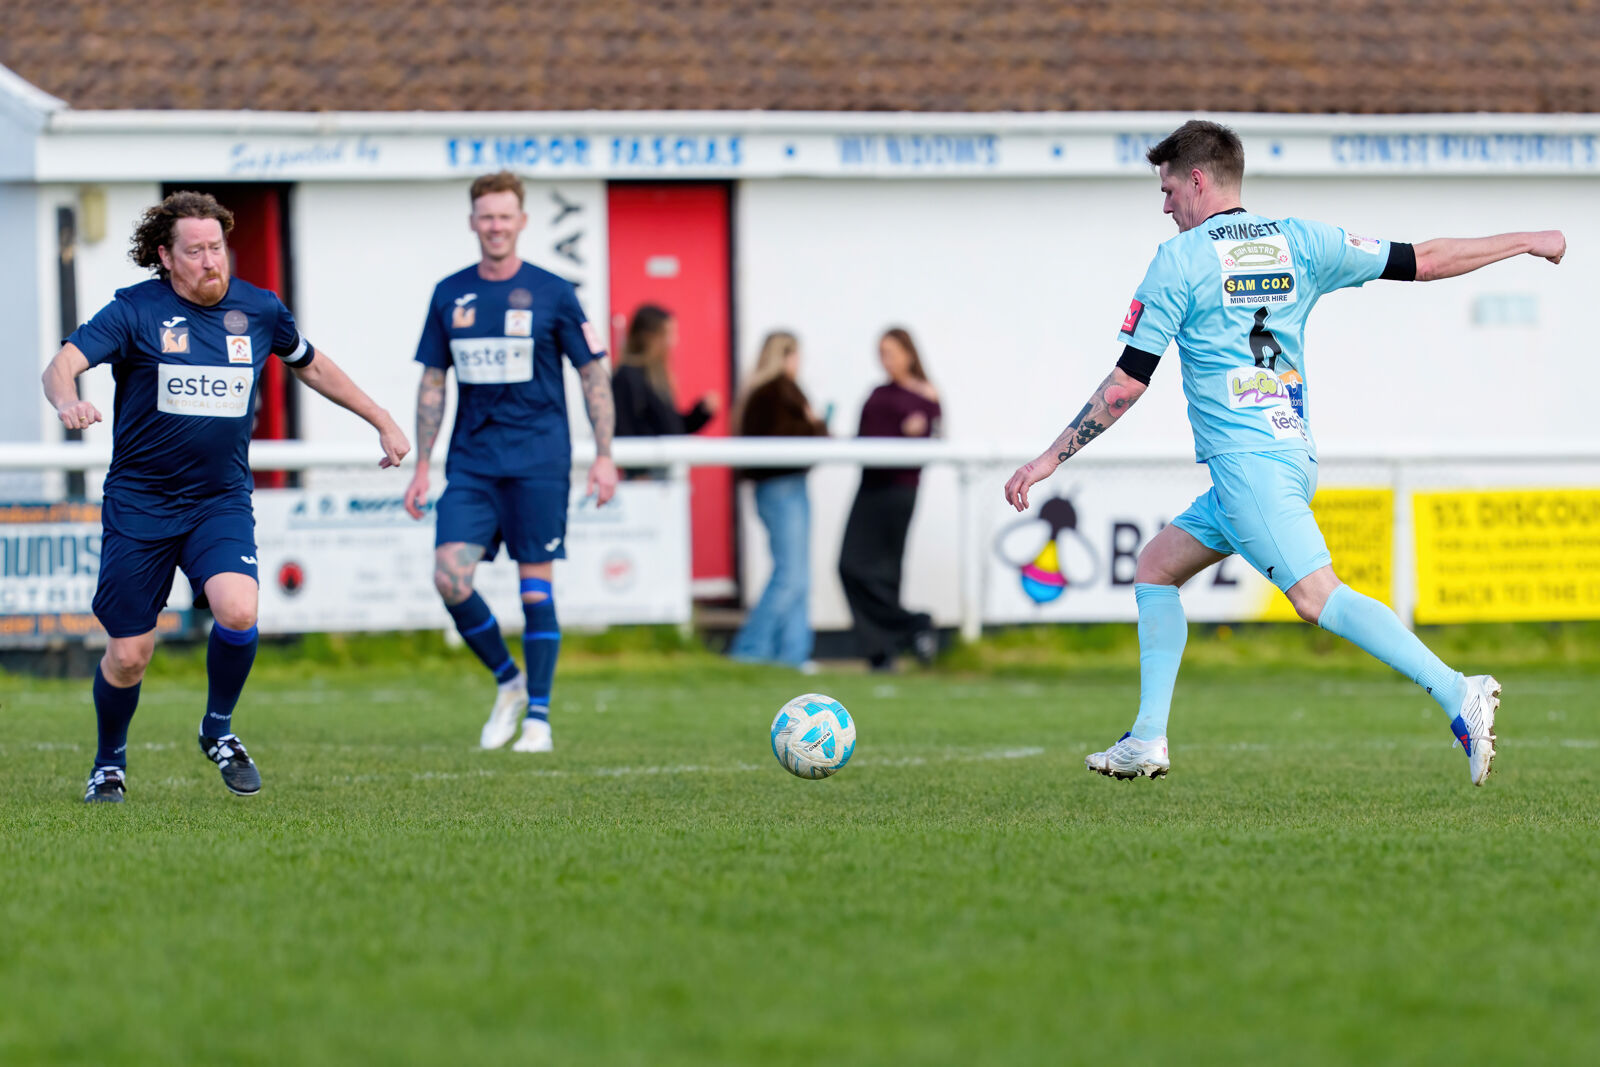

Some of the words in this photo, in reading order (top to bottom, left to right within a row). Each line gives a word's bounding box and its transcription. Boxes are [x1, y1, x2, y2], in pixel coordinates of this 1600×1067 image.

[1207, 221, 1281, 241] SPRINGETT
[552, 190, 583, 290] AY
[1226, 279, 1256, 292] SAM
[1261, 277, 1290, 290] COX
[1230, 296, 1246, 304] MINI
[1246, 295, 1271, 303] DIGGER
[1271, 294, 1288, 302] HIRE
[166, 399, 210, 409] MEDICAL
